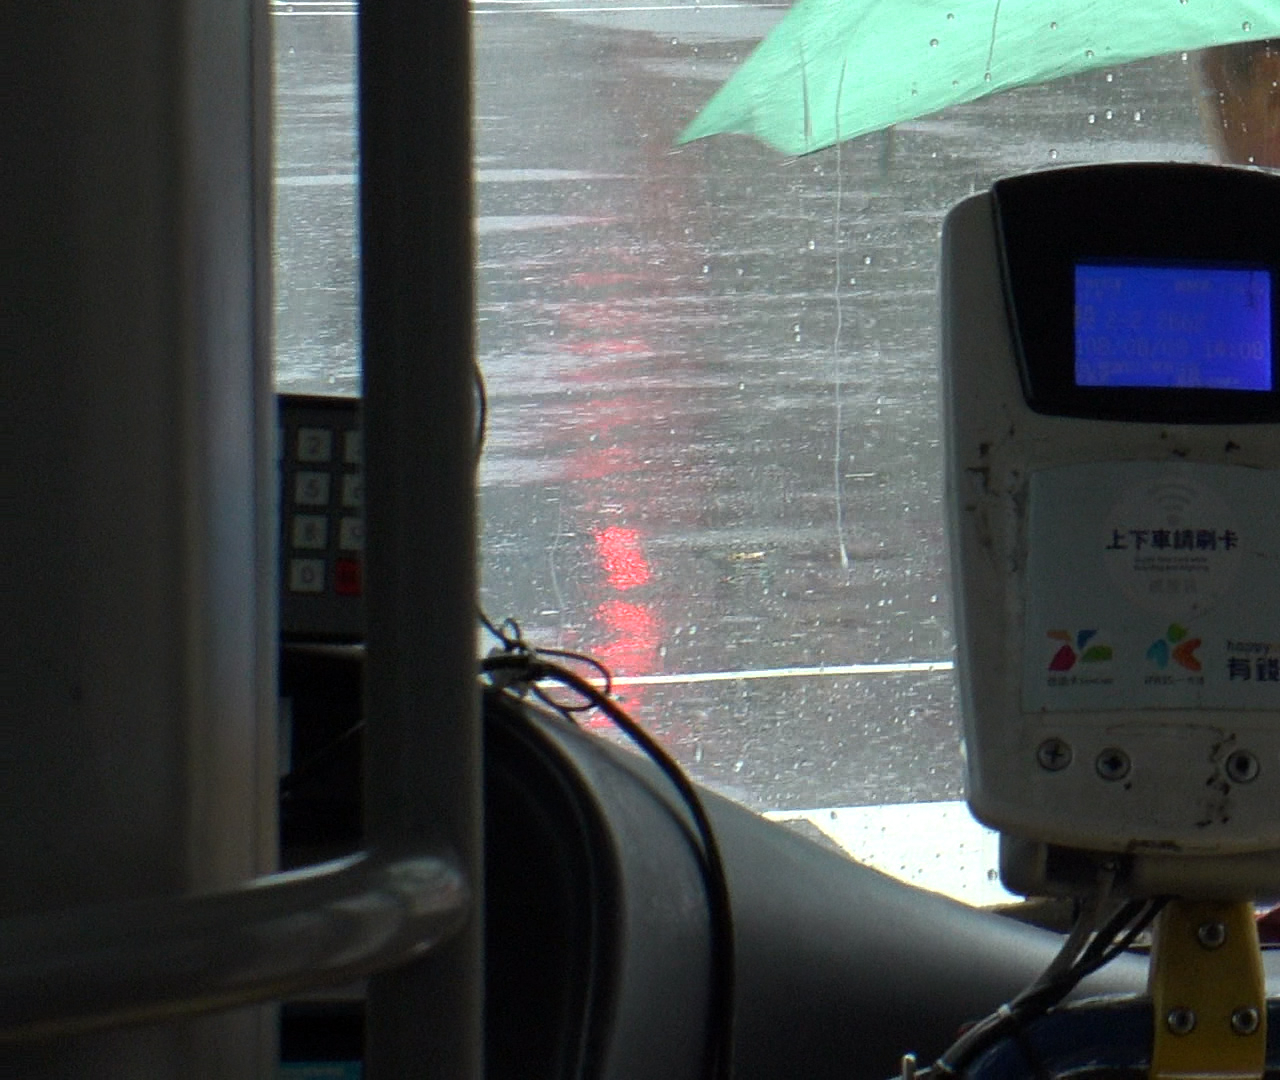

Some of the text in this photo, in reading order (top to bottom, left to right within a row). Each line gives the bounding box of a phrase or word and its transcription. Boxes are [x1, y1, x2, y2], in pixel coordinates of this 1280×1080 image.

[1106, 528, 1239, 551] 上下車請刷卡
